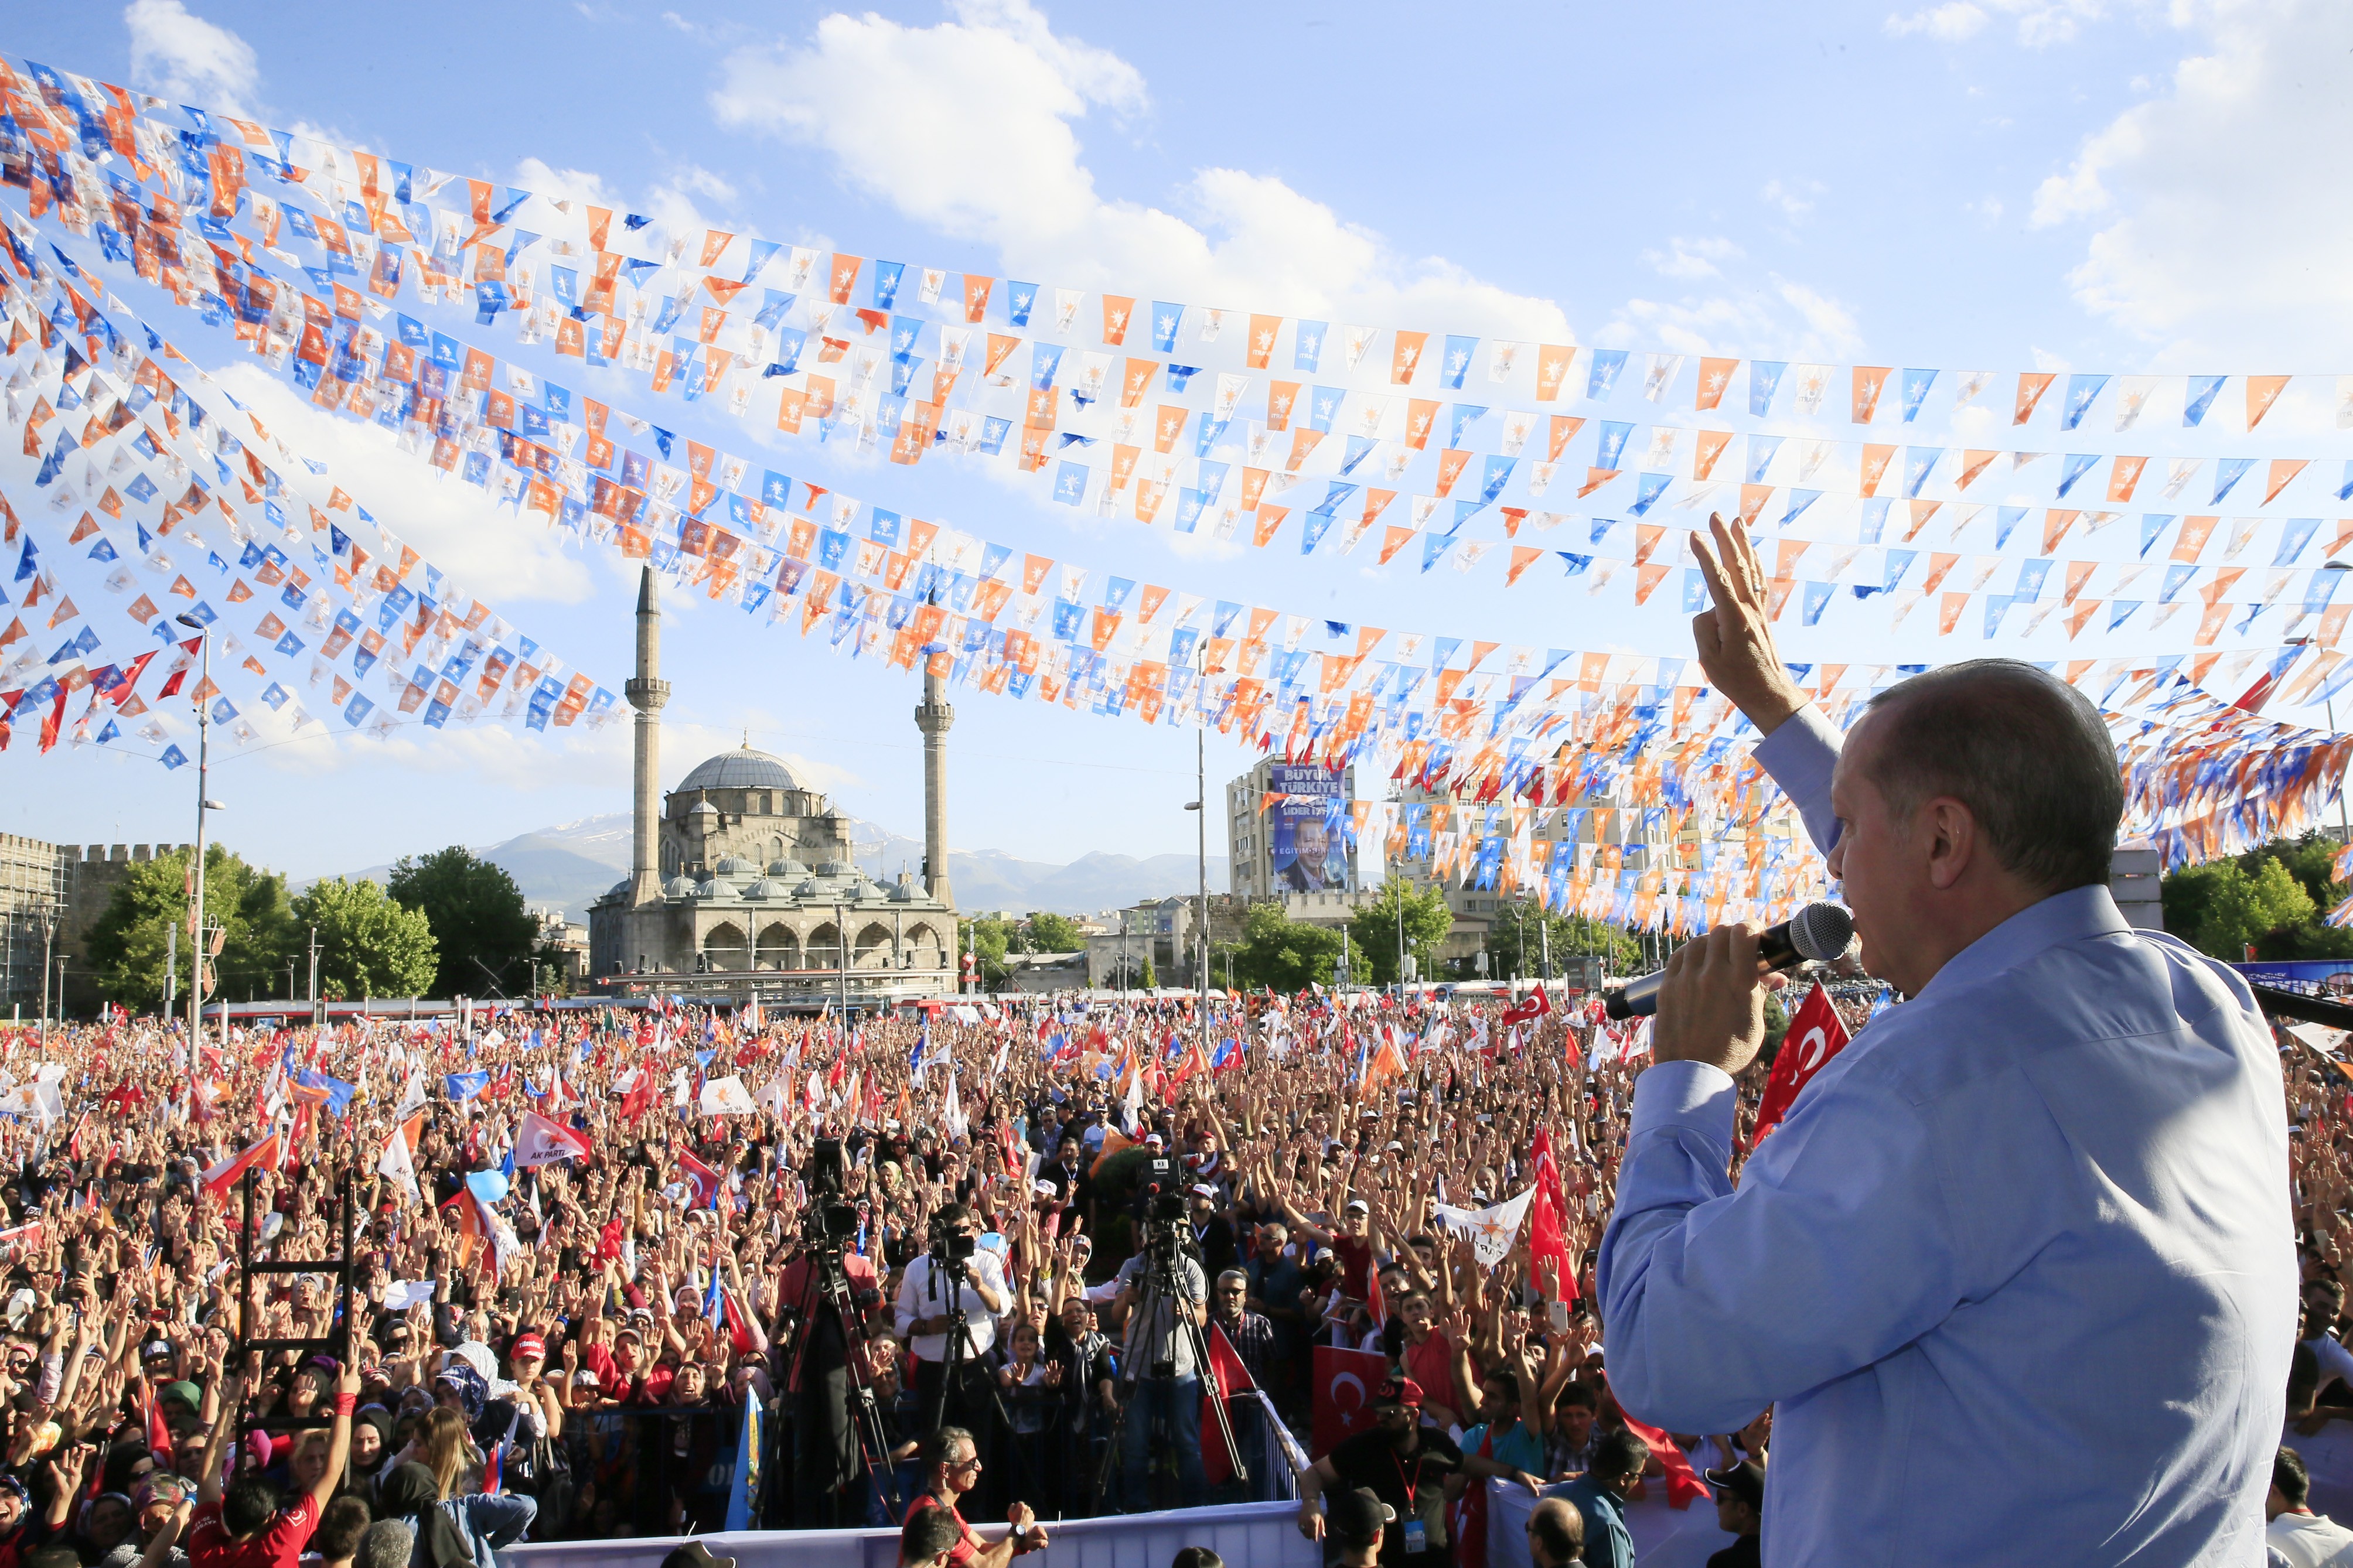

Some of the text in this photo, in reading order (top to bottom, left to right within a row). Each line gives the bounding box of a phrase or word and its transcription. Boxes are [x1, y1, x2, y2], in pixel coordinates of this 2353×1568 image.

[1284, 769, 1333, 781] BÜYÜK
[1280, 781, 1338, 793] TÜRKİYE
[1283, 807, 1310, 815] LİDER
[2326, 1033, 2338, 1044] AK
[519, 1340, 541, 1348] TÜRKİYE
